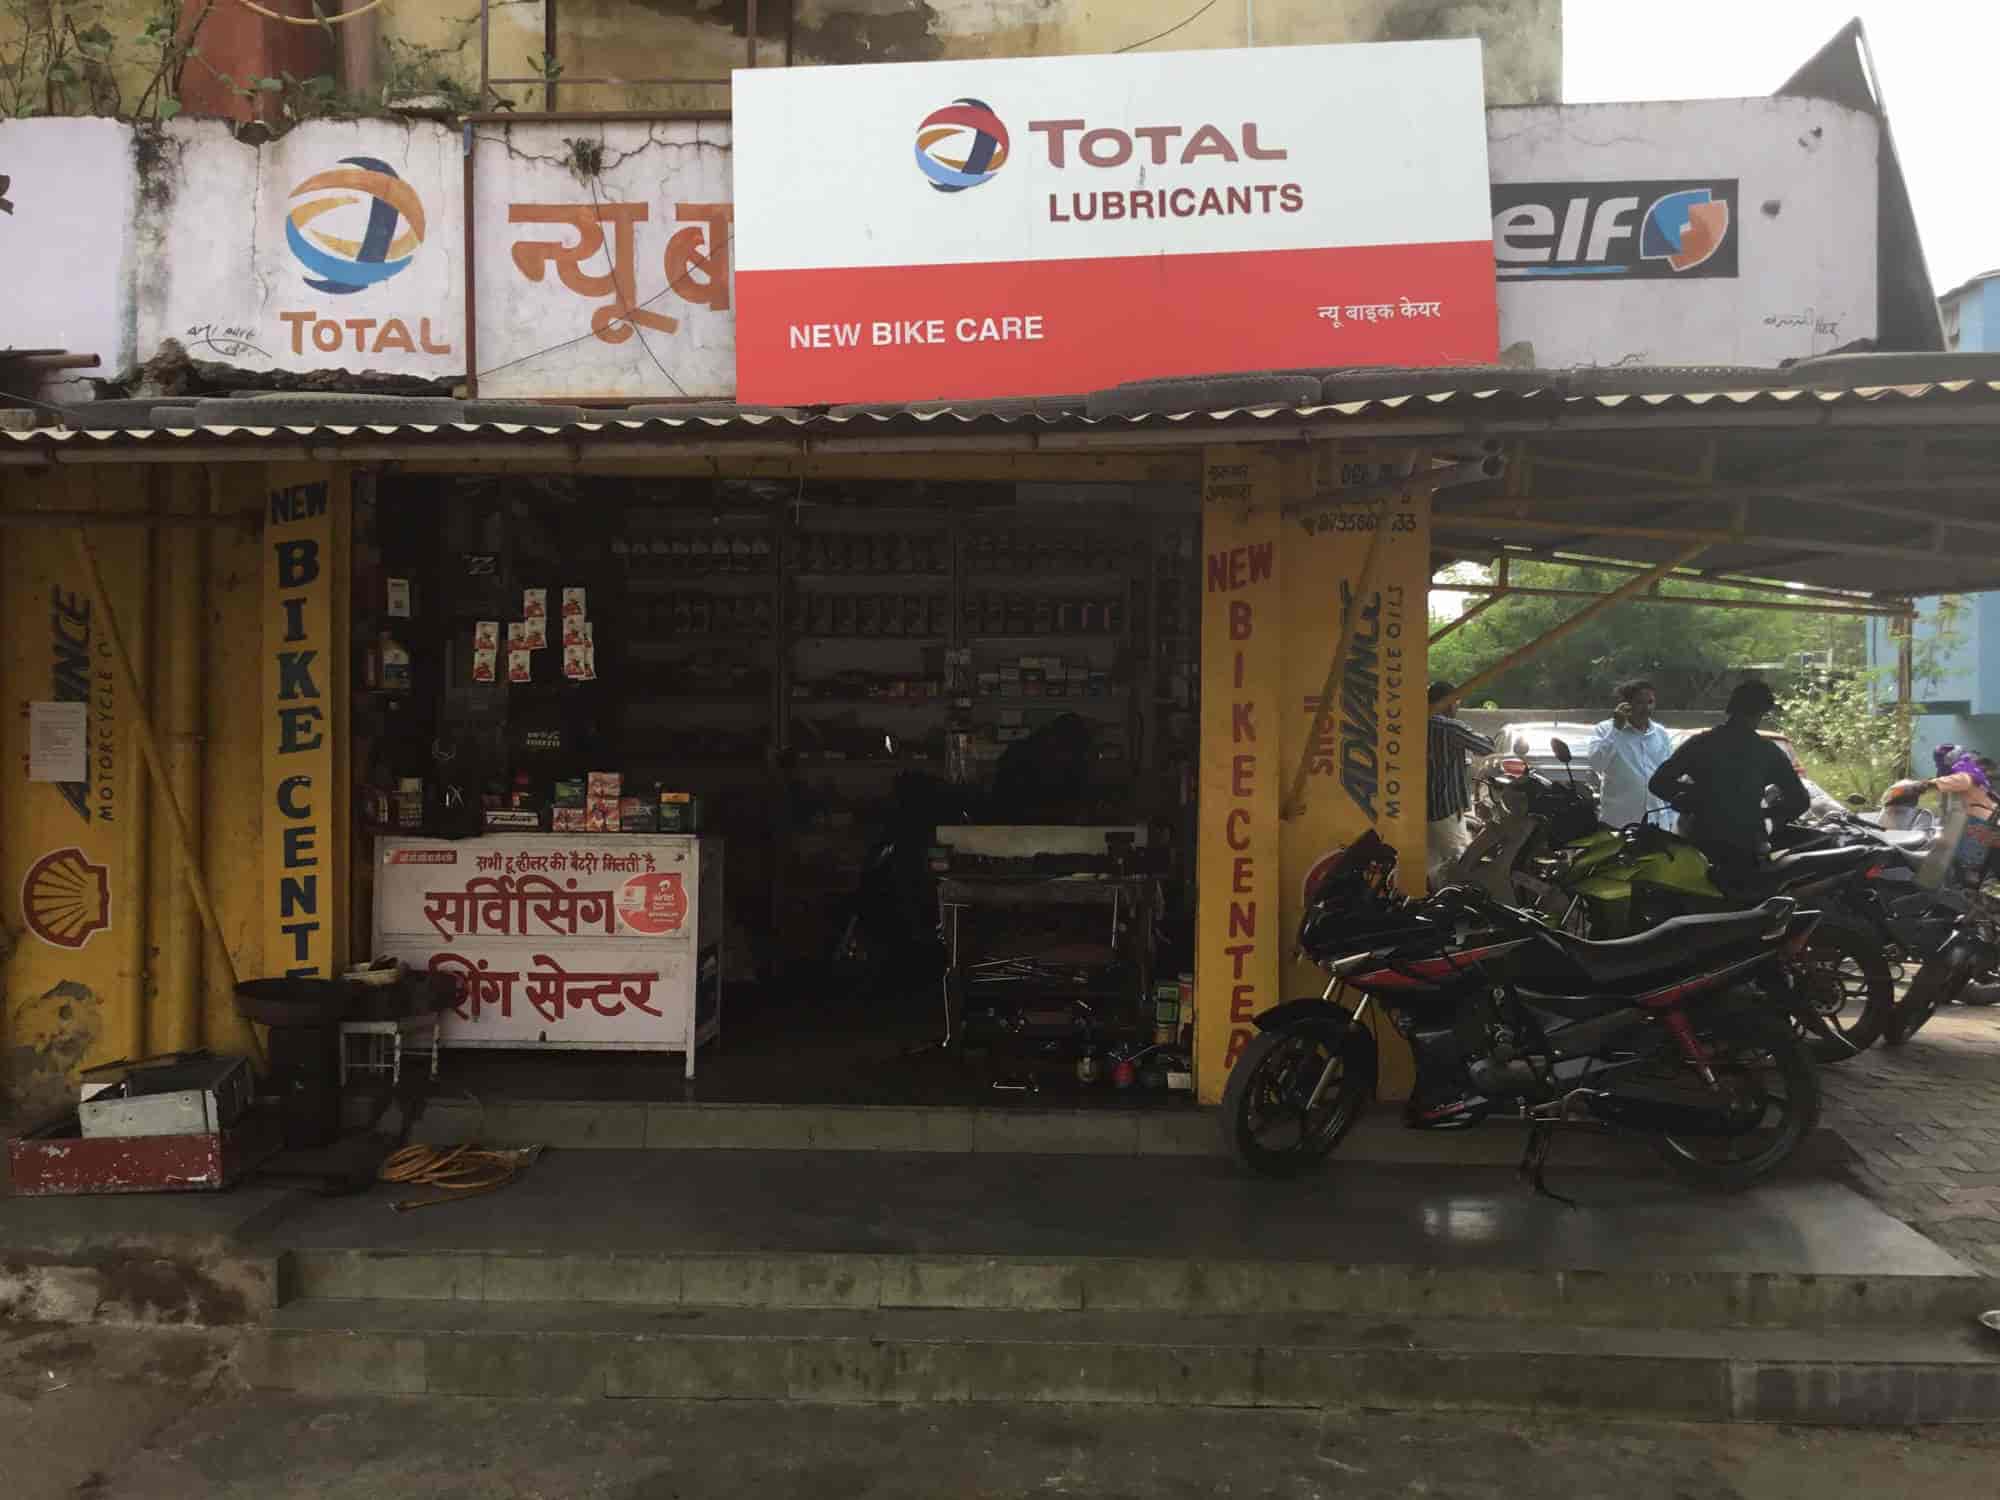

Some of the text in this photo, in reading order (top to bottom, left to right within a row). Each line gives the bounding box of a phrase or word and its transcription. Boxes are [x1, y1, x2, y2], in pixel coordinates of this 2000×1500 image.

[1028, 118, 1289, 170] TOTAL
[1049, 184, 1305, 223] LUBRICANTS
[1492, 196, 1640, 263] elf
[508, 202, 735, 343] न्यू ब
[279, 311, 451, 355] TOTAL
[789, 314, 1045, 351] NEW BIKE CARE
[1316, 296, 1442, 328] न्यू बाइक केयर
[1206, 541, 1274, 593] NEW
[270, 480, 329, 980] NEW BIKE CENT
[1229, 601, 1257, 798] BIKE
[1386, 583, 1404, 819] MOTORCYCLE OILS
[97, 671, 114, 822] MOTORCYCLE
[525, 954, 663, 1023] सेन्टर
